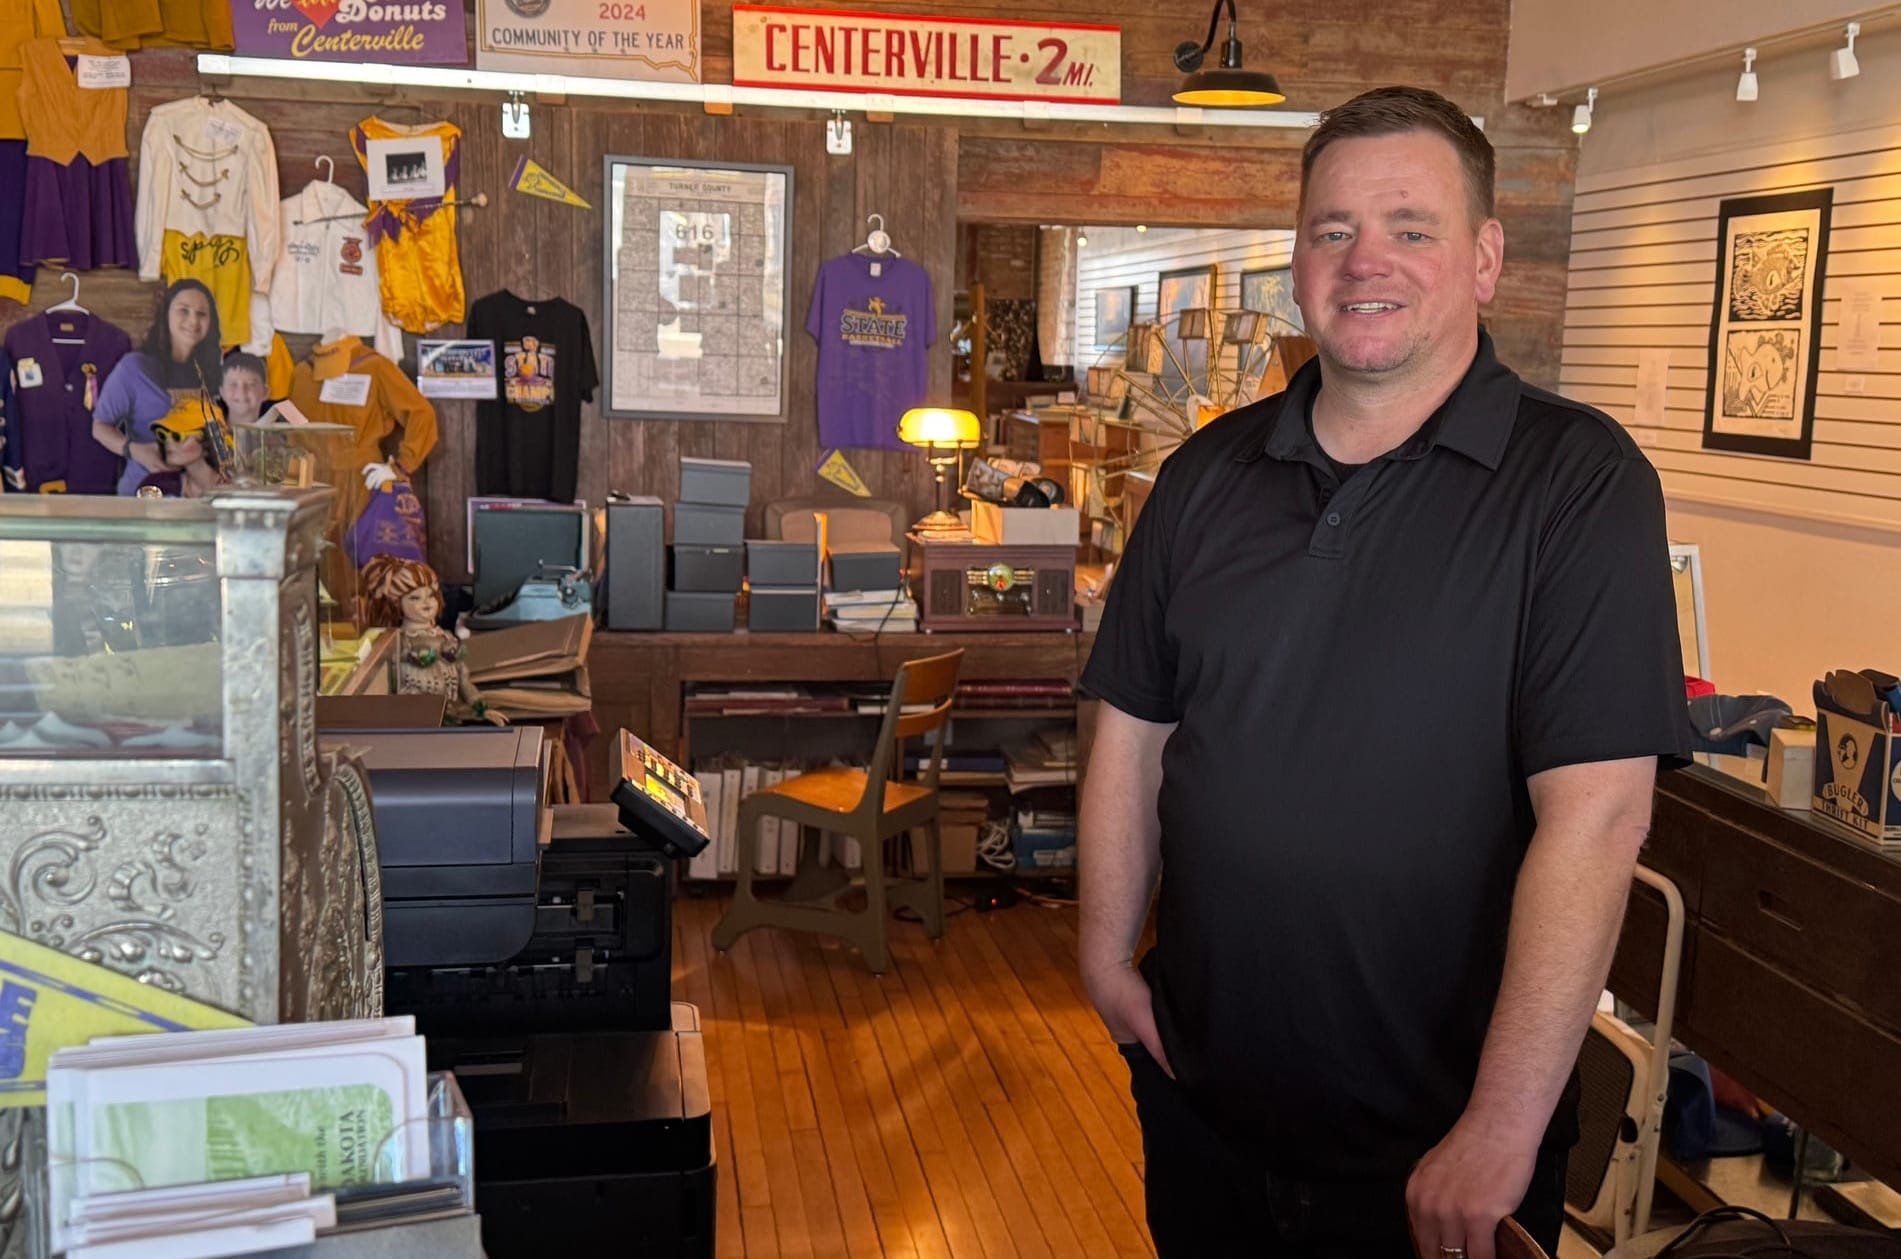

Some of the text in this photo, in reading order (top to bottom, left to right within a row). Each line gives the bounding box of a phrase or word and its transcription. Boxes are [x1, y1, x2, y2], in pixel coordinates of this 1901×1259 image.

[335, 0, 447, 23] Donuts
[600, 4, 646, 20] 2024
[268, 18, 299, 34] from
[291, 24, 425, 58] Centerville
[492, 27, 684, 49] COMMUNITY OF THE YEAR
[765, 24, 1013, 83] CENTERVILLE
[1034, 38, 1069, 85] 2
[675, 223, 714, 240] 616
[842, 315, 905, 337] STATE
[1827, 783, 1864, 809] BUGLER
[1822, 800, 1849, 821] THRIFT
[1852, 814, 1868, 832] KIT
